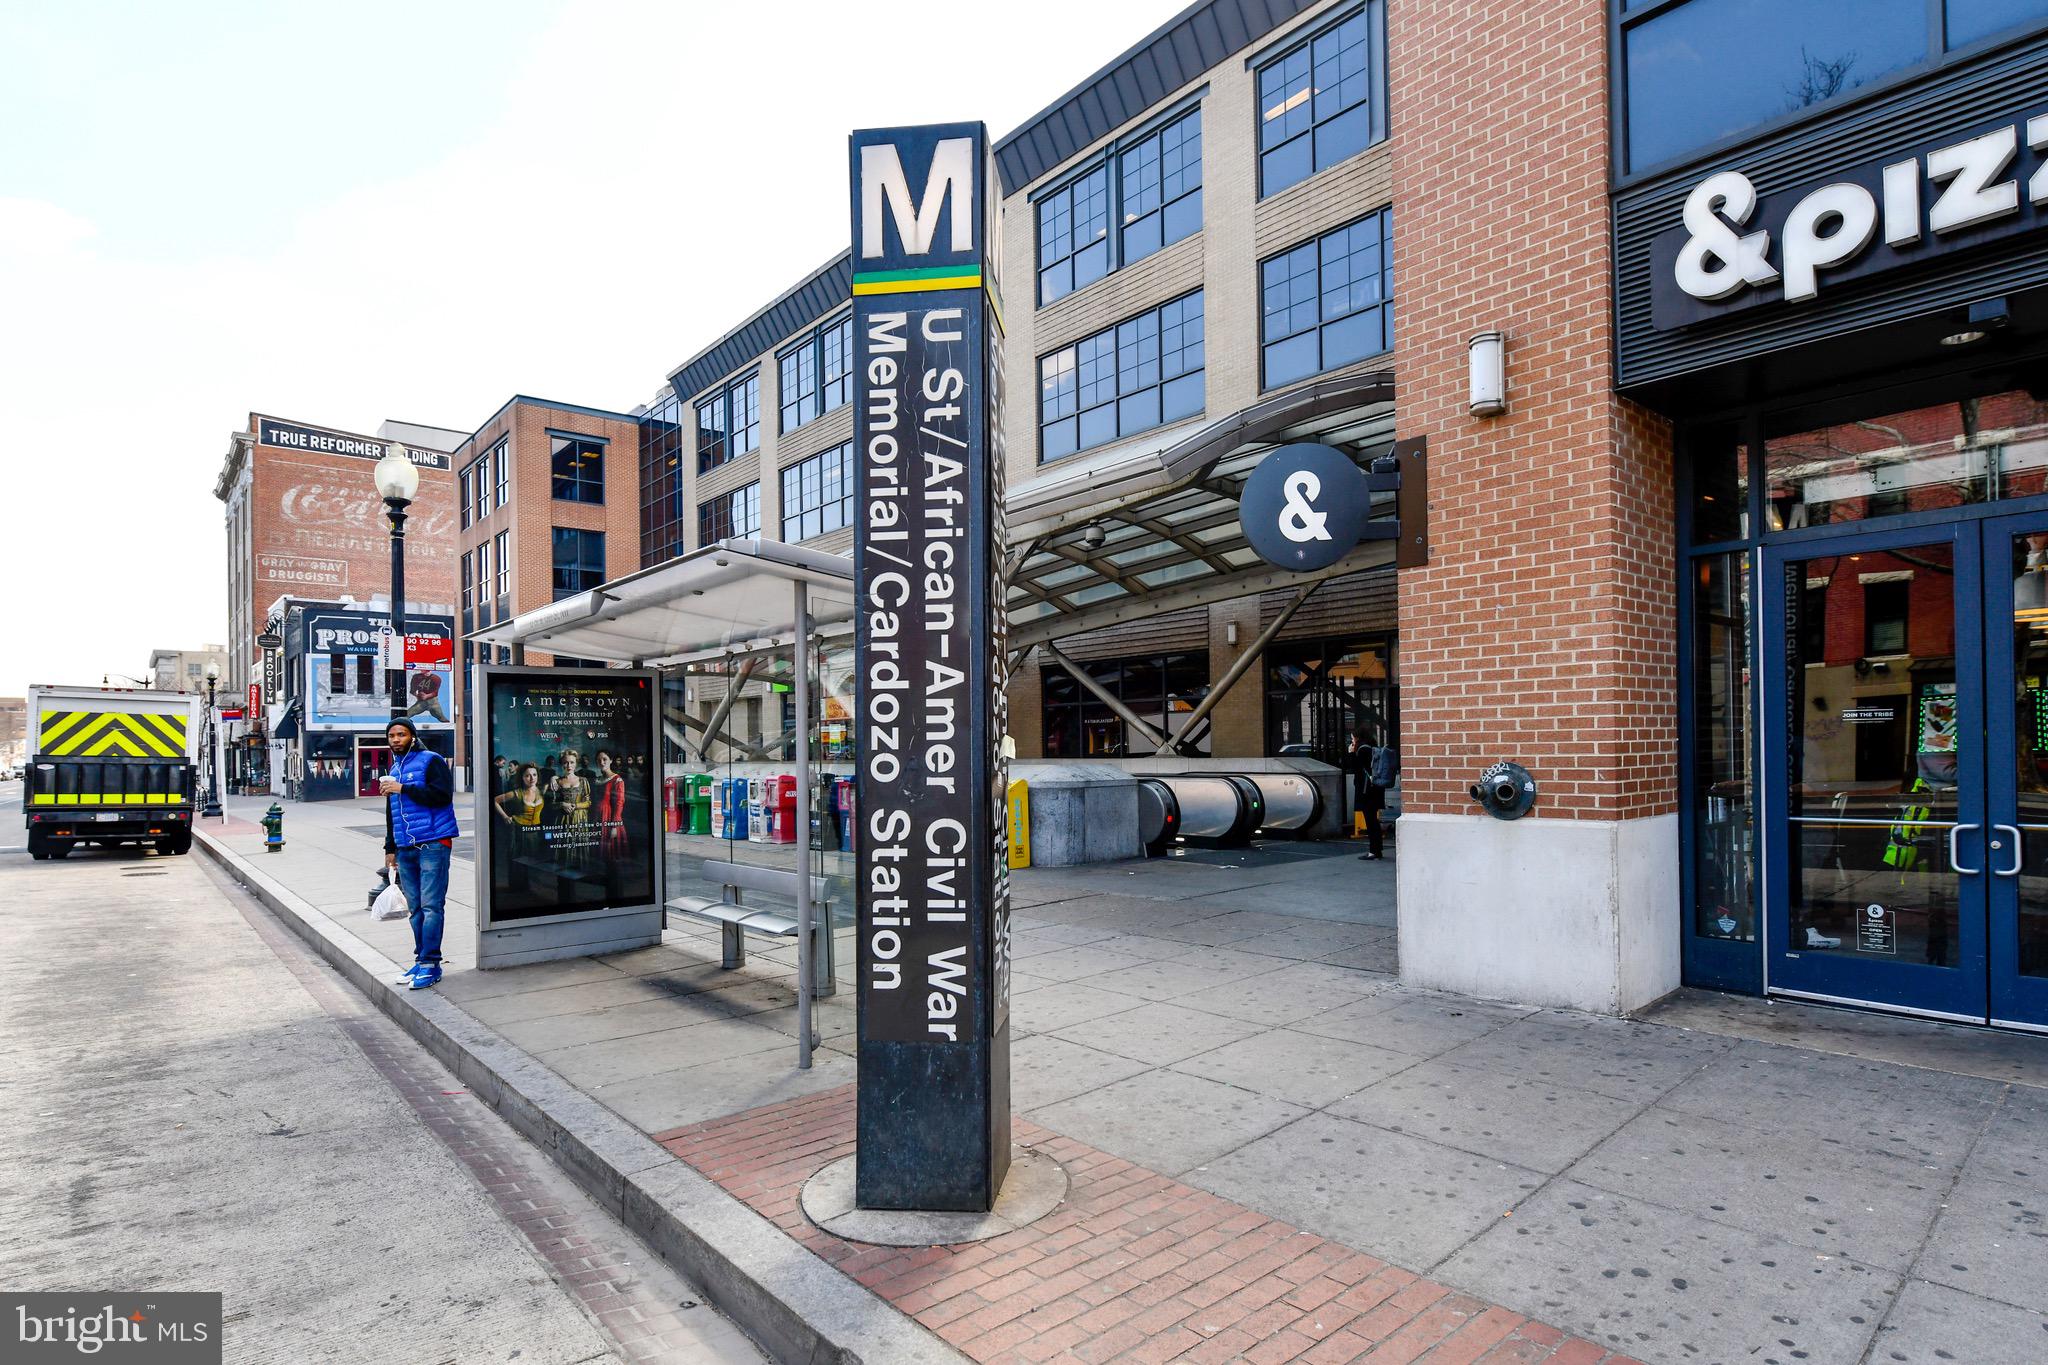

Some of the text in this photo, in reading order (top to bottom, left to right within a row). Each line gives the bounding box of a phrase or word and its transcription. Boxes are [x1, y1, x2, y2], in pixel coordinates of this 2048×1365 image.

[861, 137, 973, 259] M
[922, 309, 962, 342] U
[269, 430, 307, 447] TRUE
[310, 435, 381, 457] REFORMER
[1278, 470, 1333, 542] &
[261, 558, 294, 567] GRAY
[310, 561, 342, 572] GRAY
[269, 569, 338, 583] DRUGGISTS
[866, 312, 914, 990] Memorial/Cardozo Station
[266, 650, 274, 703] BROOKLYN
[550, 841, 599, 849] weta.org/jamestown
[574, 830, 602, 839] Passport
[925, 818, 967, 922] Civil
[927, 946, 967, 1042] War
